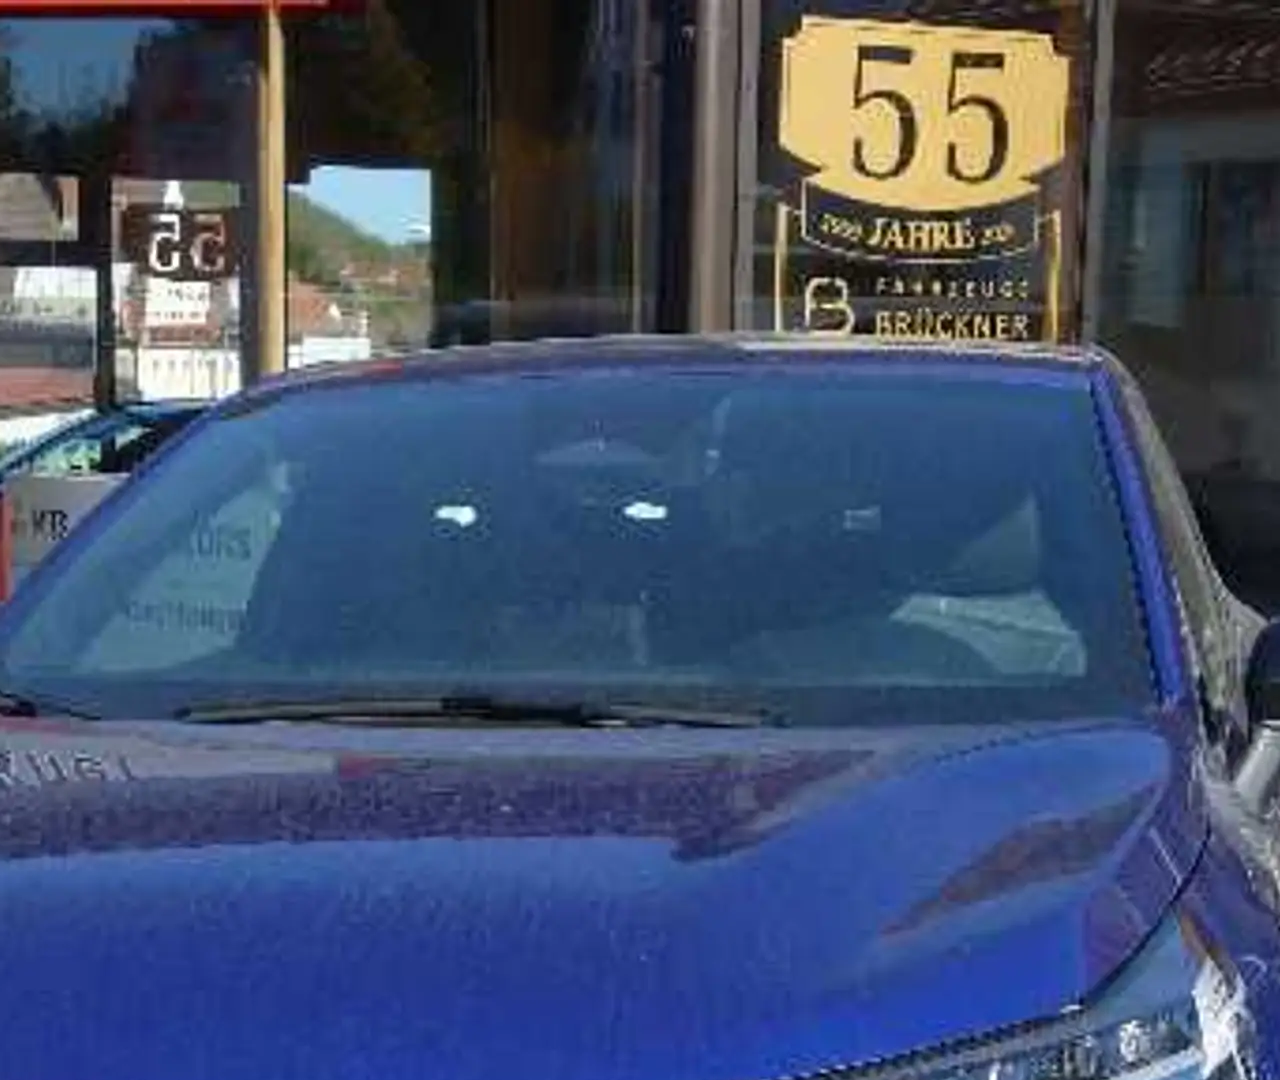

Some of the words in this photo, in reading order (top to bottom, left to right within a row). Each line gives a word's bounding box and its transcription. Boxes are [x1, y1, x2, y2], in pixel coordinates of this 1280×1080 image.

[852, 44, 1009, 185] 55
[867, 217, 976, 250] JAHRE
[875, 305, 1029, 340] BRÜCKNER
